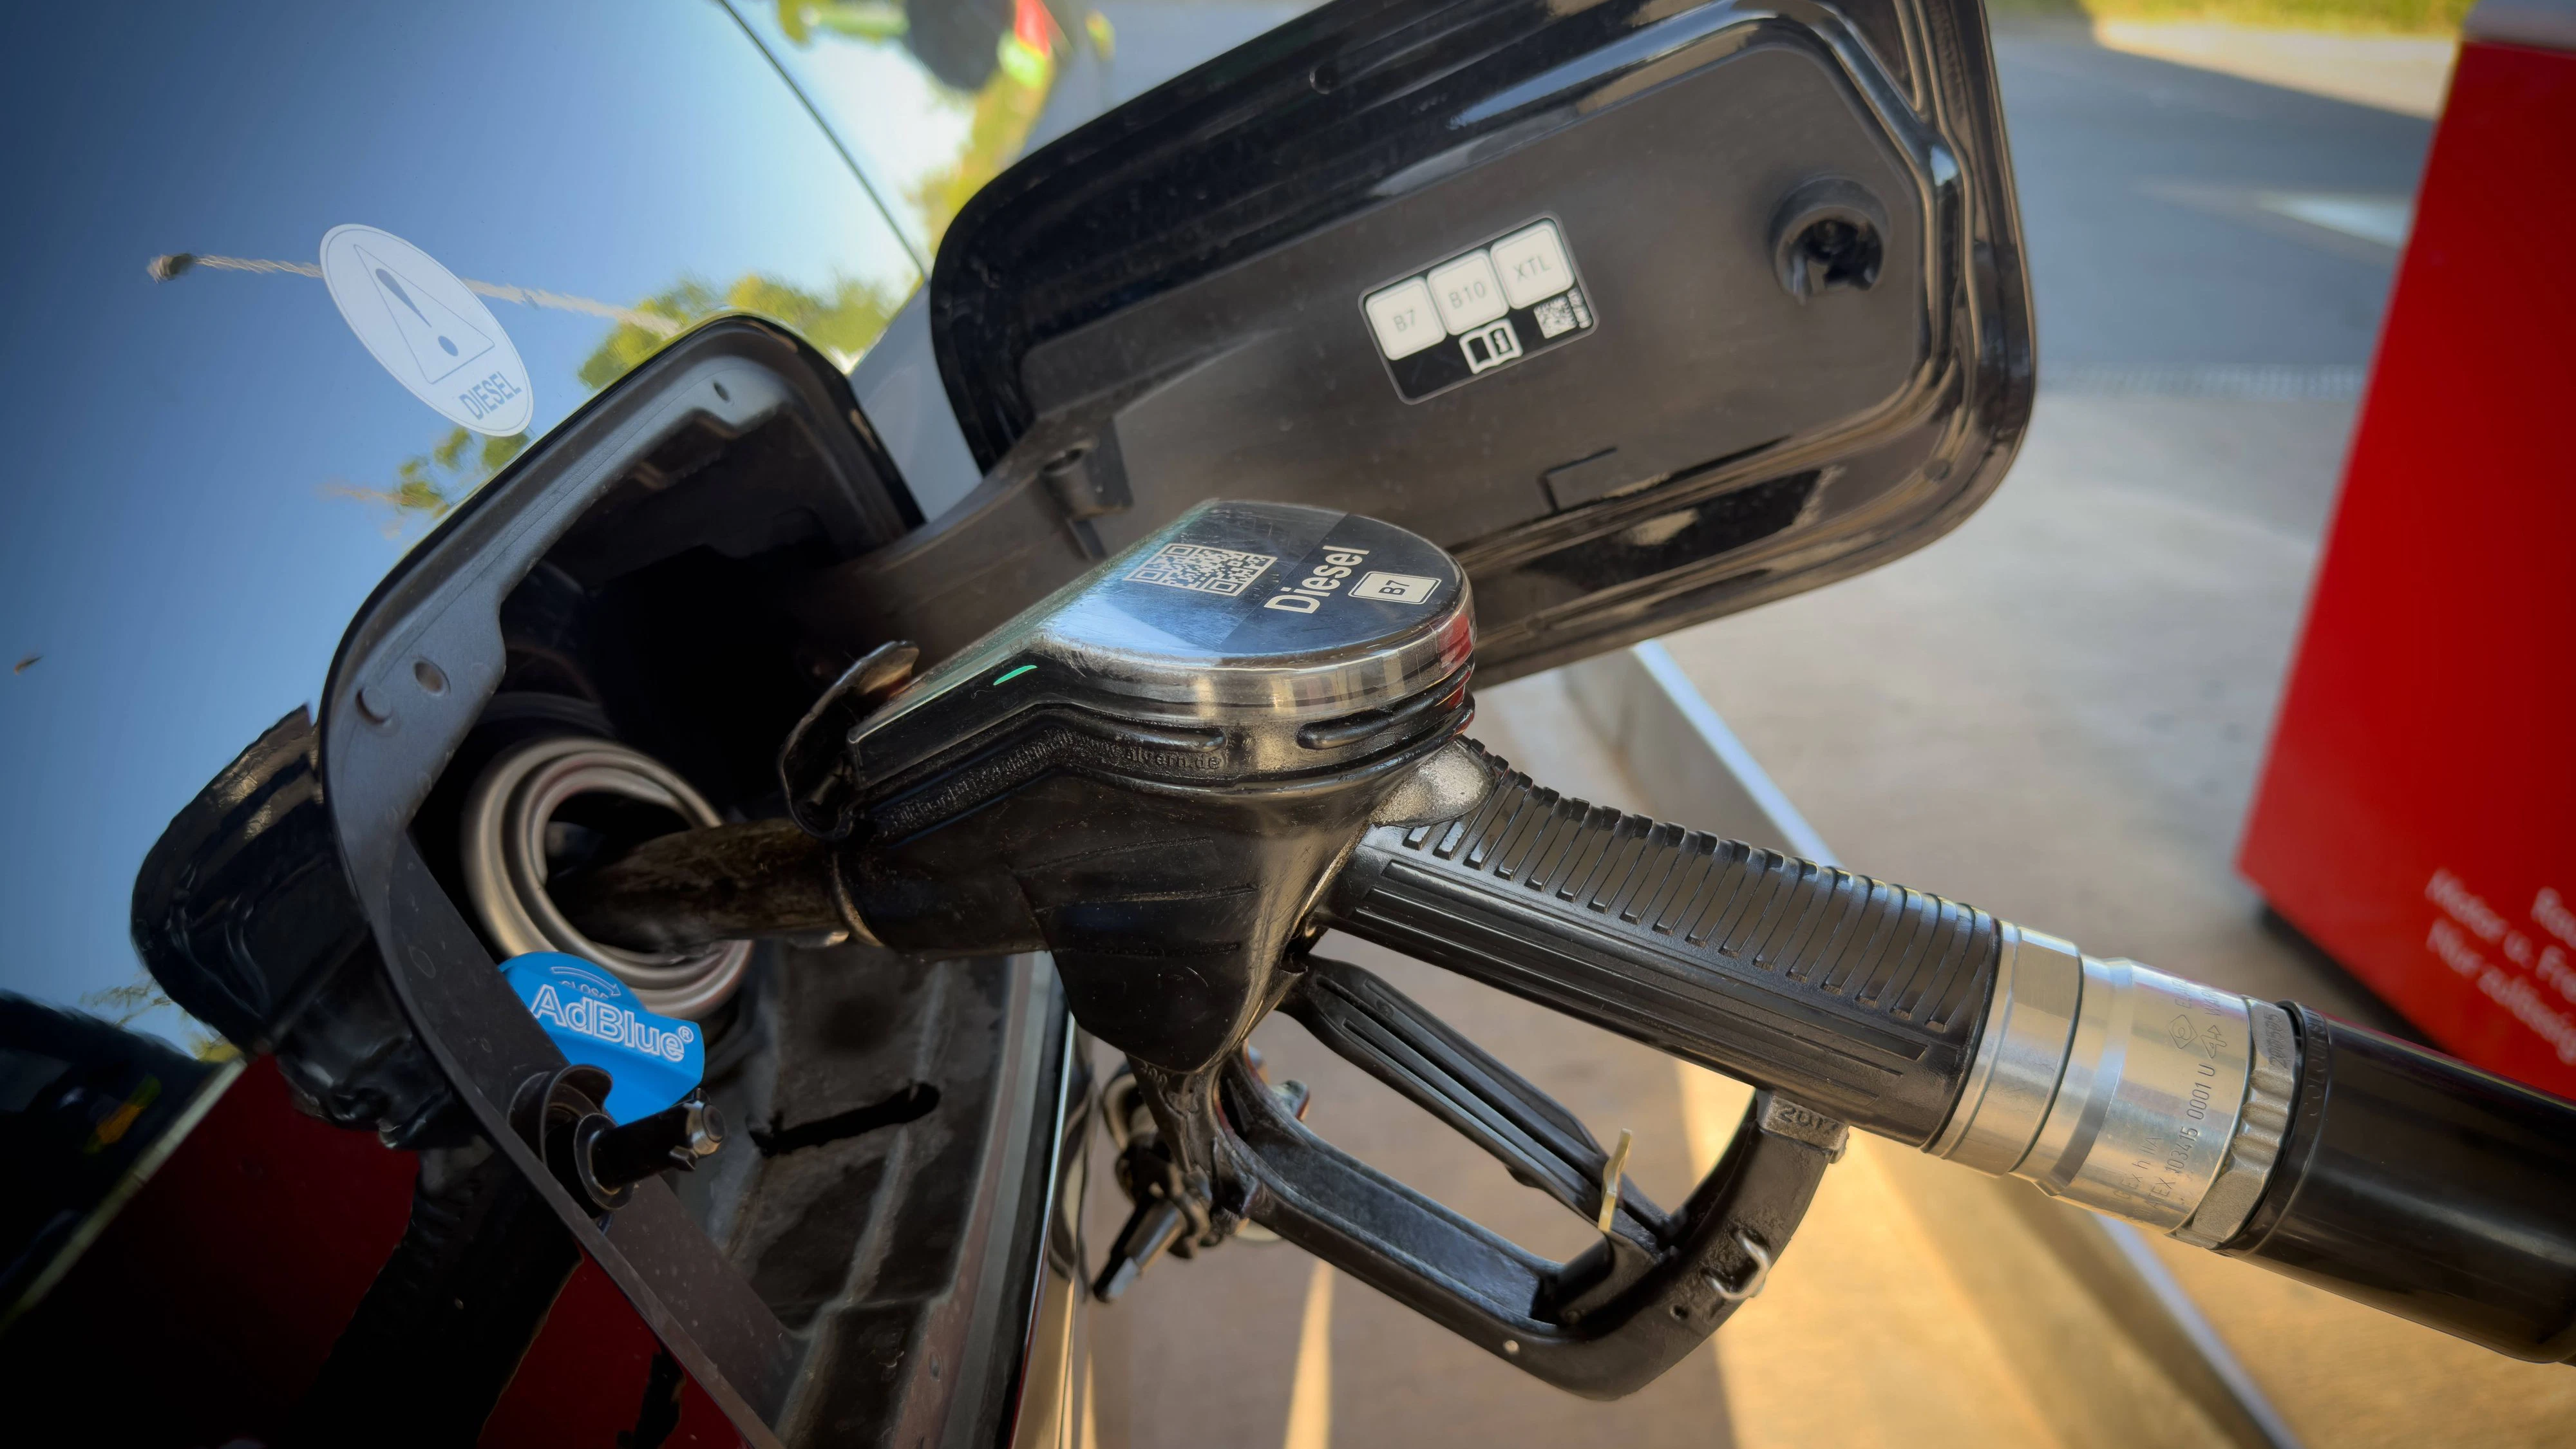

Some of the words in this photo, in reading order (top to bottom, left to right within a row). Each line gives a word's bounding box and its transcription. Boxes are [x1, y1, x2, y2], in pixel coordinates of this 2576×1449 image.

[1393, 308, 1417, 333] B7
[1448, 279, 1487, 309] B10
[1513, 254, 1553, 282] XTL
[459, 372, 522, 421] DIESEL
[1264, 545, 1370, 614] Diesel
[1378, 580, 1410, 596] B7
[2145, 1177, 2176, 1208] ATEX
[2186, 1082, 2211, 1120] 0001
[2199, 1063, 2215, 1077] U
[2121, 1173, 2143, 1190] Ex
[2132, 1160, 2150, 1170] h
